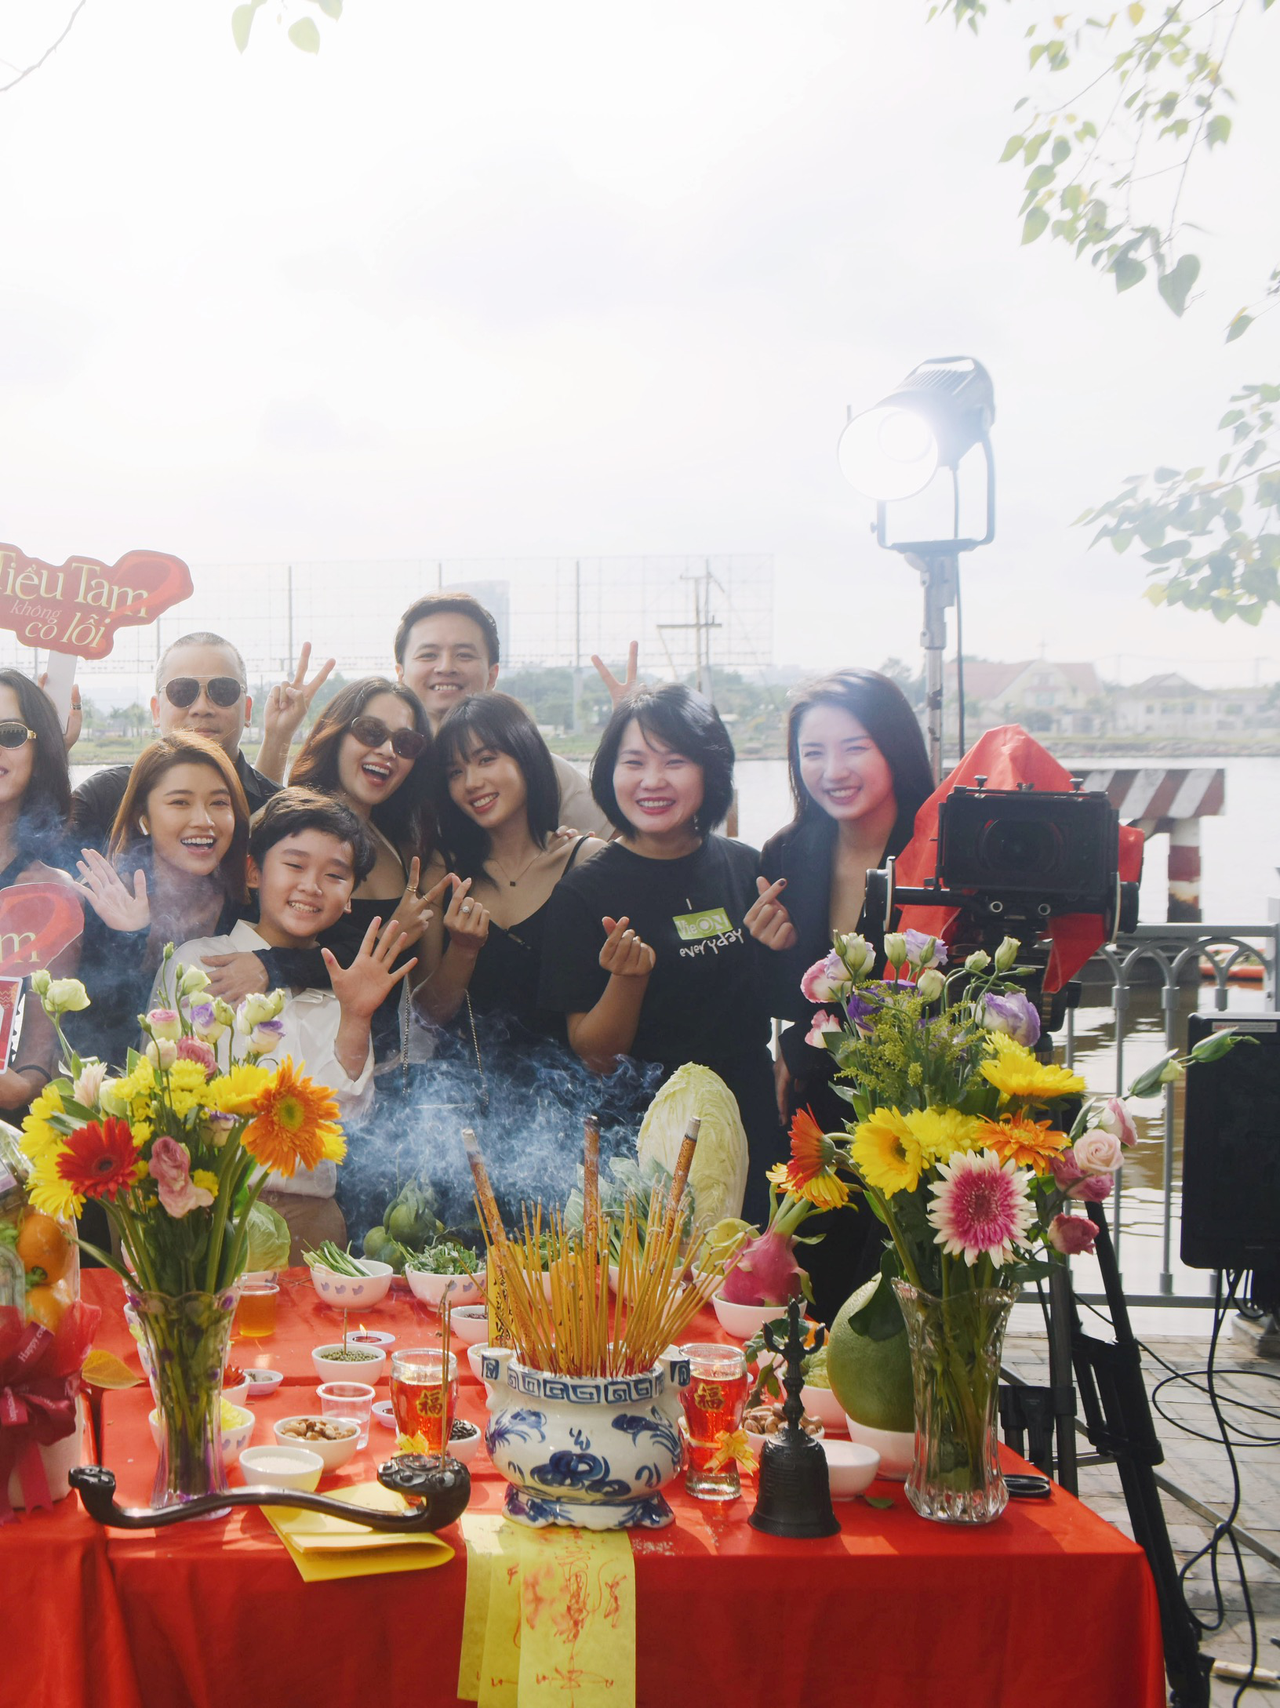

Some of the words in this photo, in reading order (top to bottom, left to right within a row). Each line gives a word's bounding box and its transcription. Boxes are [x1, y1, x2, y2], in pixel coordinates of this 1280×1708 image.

[71, 562, 149, 618] Tam
[10, 600, 62, 624] không
[60, 612, 111, 648] lỗi
[679, 928, 744, 957] everyday
[417, 1389, 444, 1418] 福
[694, 1383, 725, 1413] 福
